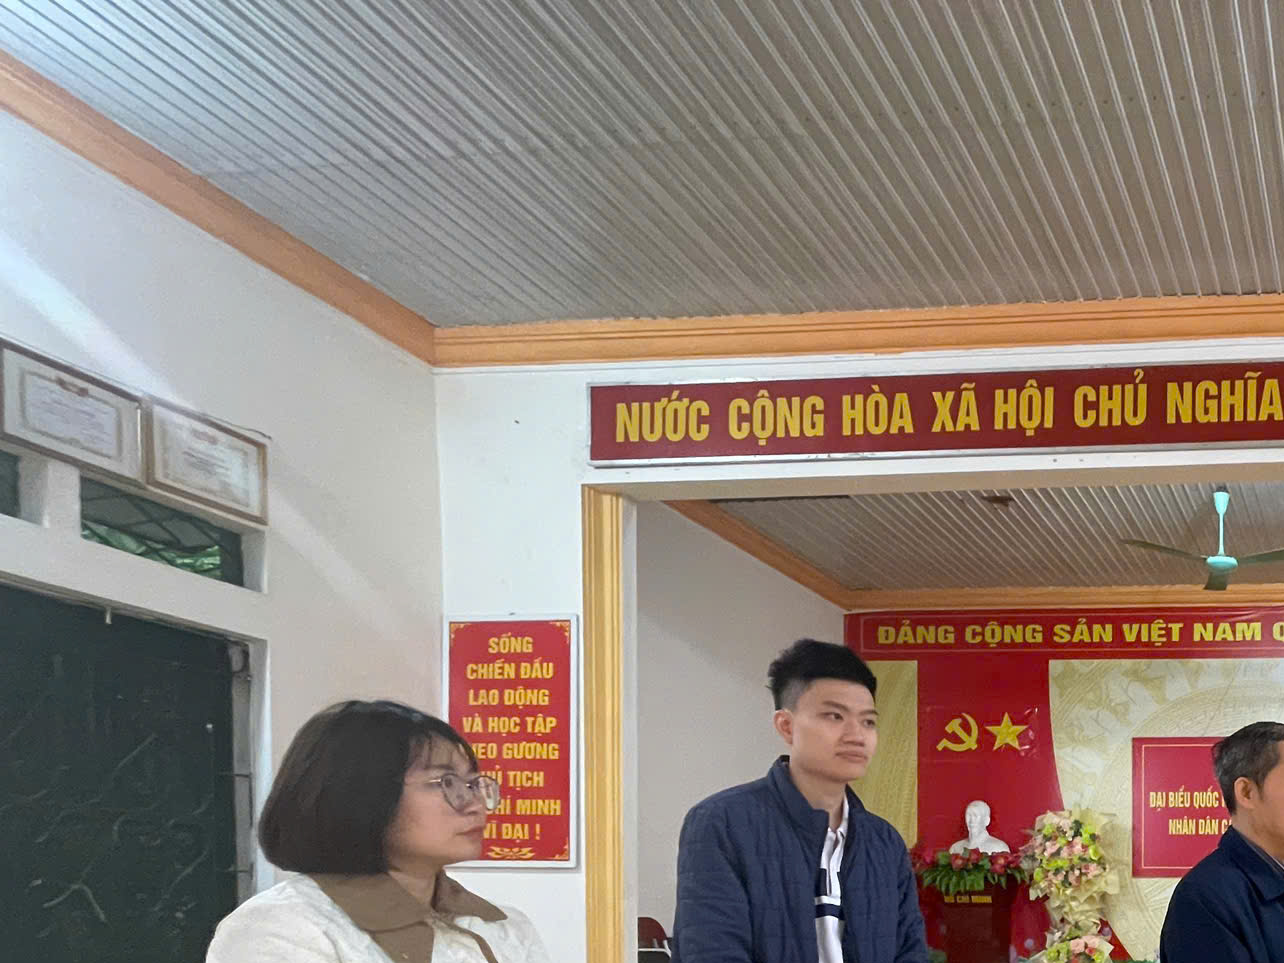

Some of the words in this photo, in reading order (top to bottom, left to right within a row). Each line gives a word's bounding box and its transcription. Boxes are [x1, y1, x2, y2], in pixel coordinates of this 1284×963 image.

[616, 390, 710, 443] NƯỚC
[728, 389, 825, 447] CỘNG
[842, 385, 914, 436] HÒA
[932, 382, 981, 433] XÃ
[994, 378, 1054, 437] HỘI
[1074, 368, 1148, 428] CHỦ
[1166, 371, 1284, 424] NGHĨA
[488, 632, 534, 655] SỐNG
[877, 619, 956, 645] ĐẢNG
[965, 621, 1043, 647] CỘNG
[1053, 618, 1113, 643] SẢN
[1123, 618, 1184, 647] VIỆT
[1194, 622, 1262, 642] NAM
[466, 658, 516, 680] CHIẾN
[519, 656, 554, 680] ĐẤU
[469, 688, 500, 706] LAO
[503, 686, 550, 710] ĐỘNG
[462, 713, 483, 733] VÀ
[487, 716, 521, 737] HỌC
[525, 713, 558, 737] TẬP
[502, 741, 560, 761] GƯƠNG
[506, 770, 545, 791] TỊCH
[515, 798, 562, 816] MINH
[1193, 785, 1219, 809] QUỐC
[502, 823, 530, 844] ĐẠI
[1168, 815, 1196, 835] NHÂN
[1198, 815, 1219, 835] DÂN
